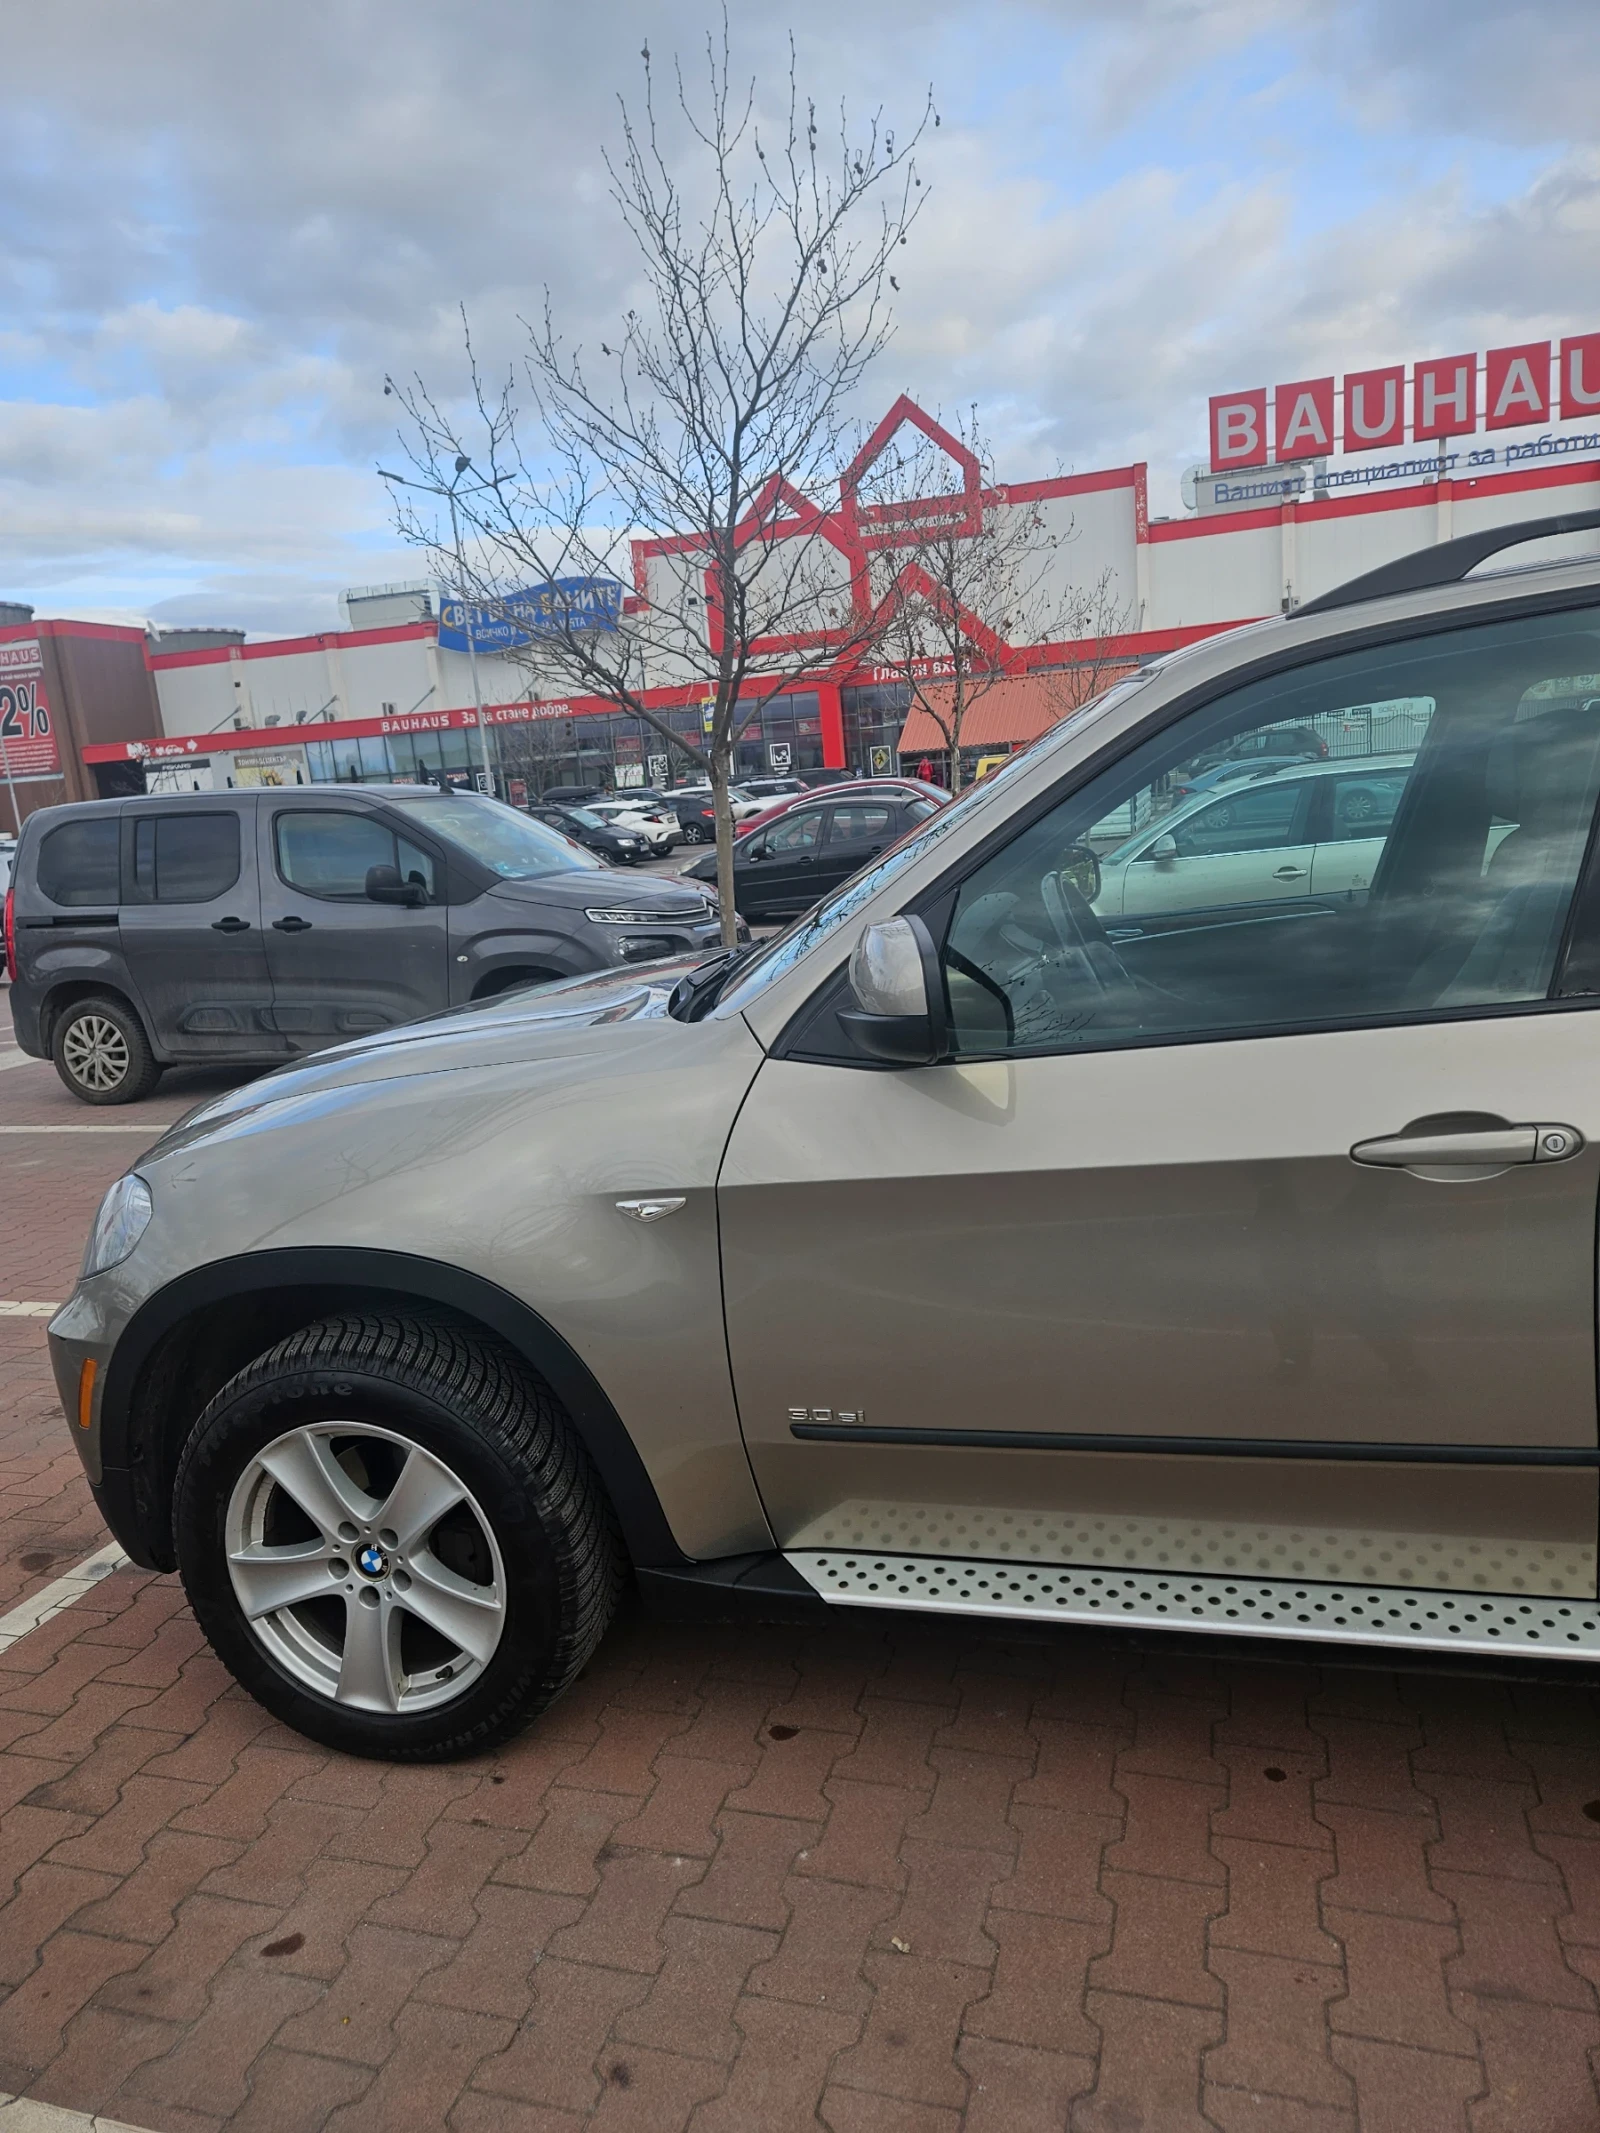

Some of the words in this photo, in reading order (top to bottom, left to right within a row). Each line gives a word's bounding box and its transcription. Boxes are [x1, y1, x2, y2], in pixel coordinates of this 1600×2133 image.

[1218, 349, 1600, 460] BAUHAU
[1215, 476, 1305, 504] Вашият
[1314, 453, 1459, 489] специалист
[1468, 448, 1495, 467] за
[1, 648, 39, 664] HAUS
[0, 683, 49, 737] 2%
[382, 715, 449, 732] BAUHAUS
[462, 711, 476, 724] За
[496, 707, 529, 721] стане
[531, 702, 573, 719] добре.
[370, 1543, 388, 1573] BMW
